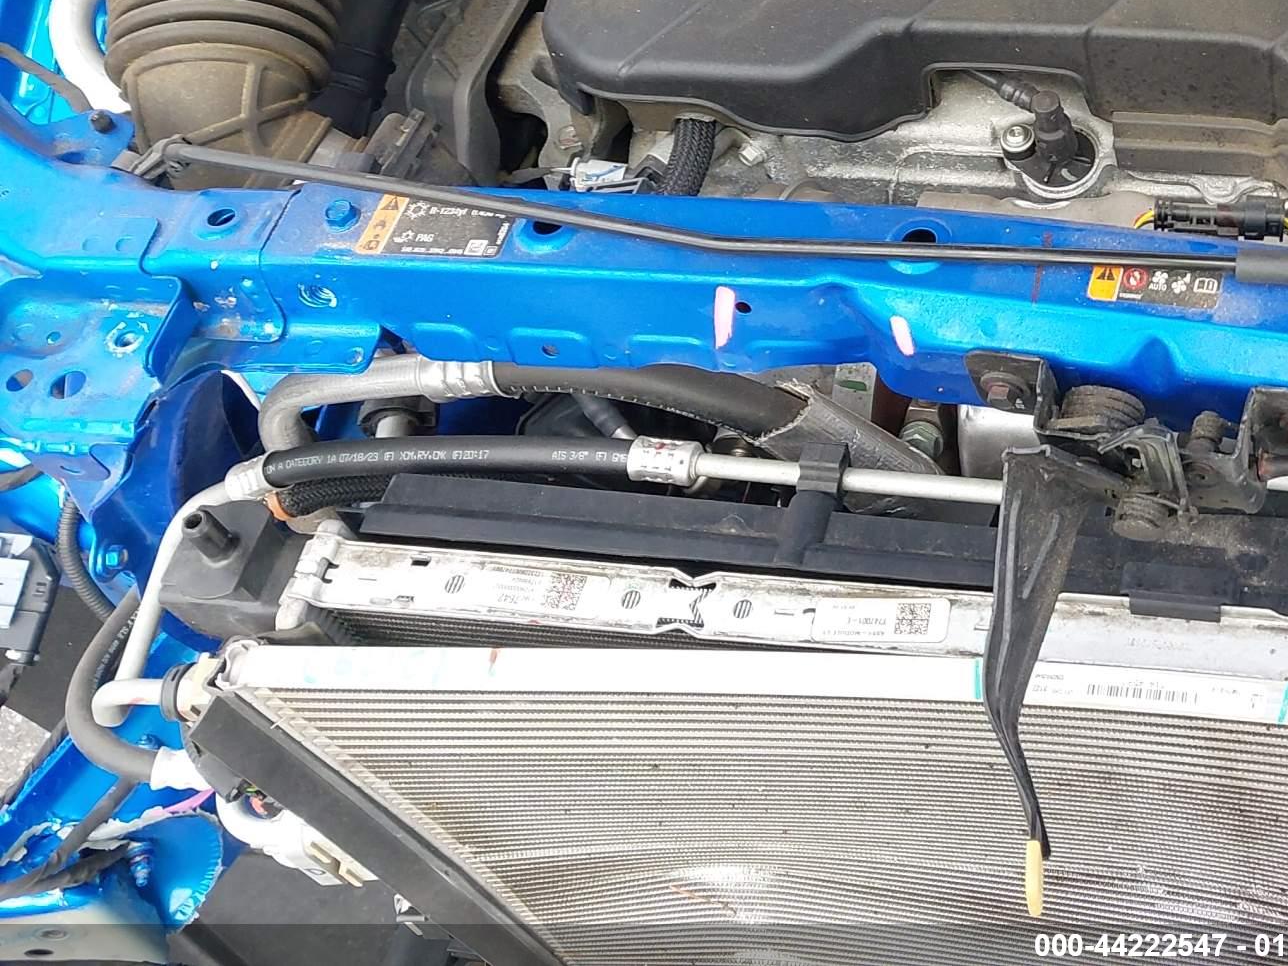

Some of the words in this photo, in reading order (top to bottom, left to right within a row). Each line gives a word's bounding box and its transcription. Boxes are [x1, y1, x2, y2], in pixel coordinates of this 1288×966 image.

[416, 233, 434, 243] PAG
[1149, 283, 1168, 291] AUTO
[339, 452, 379, 463] 07/18/23
